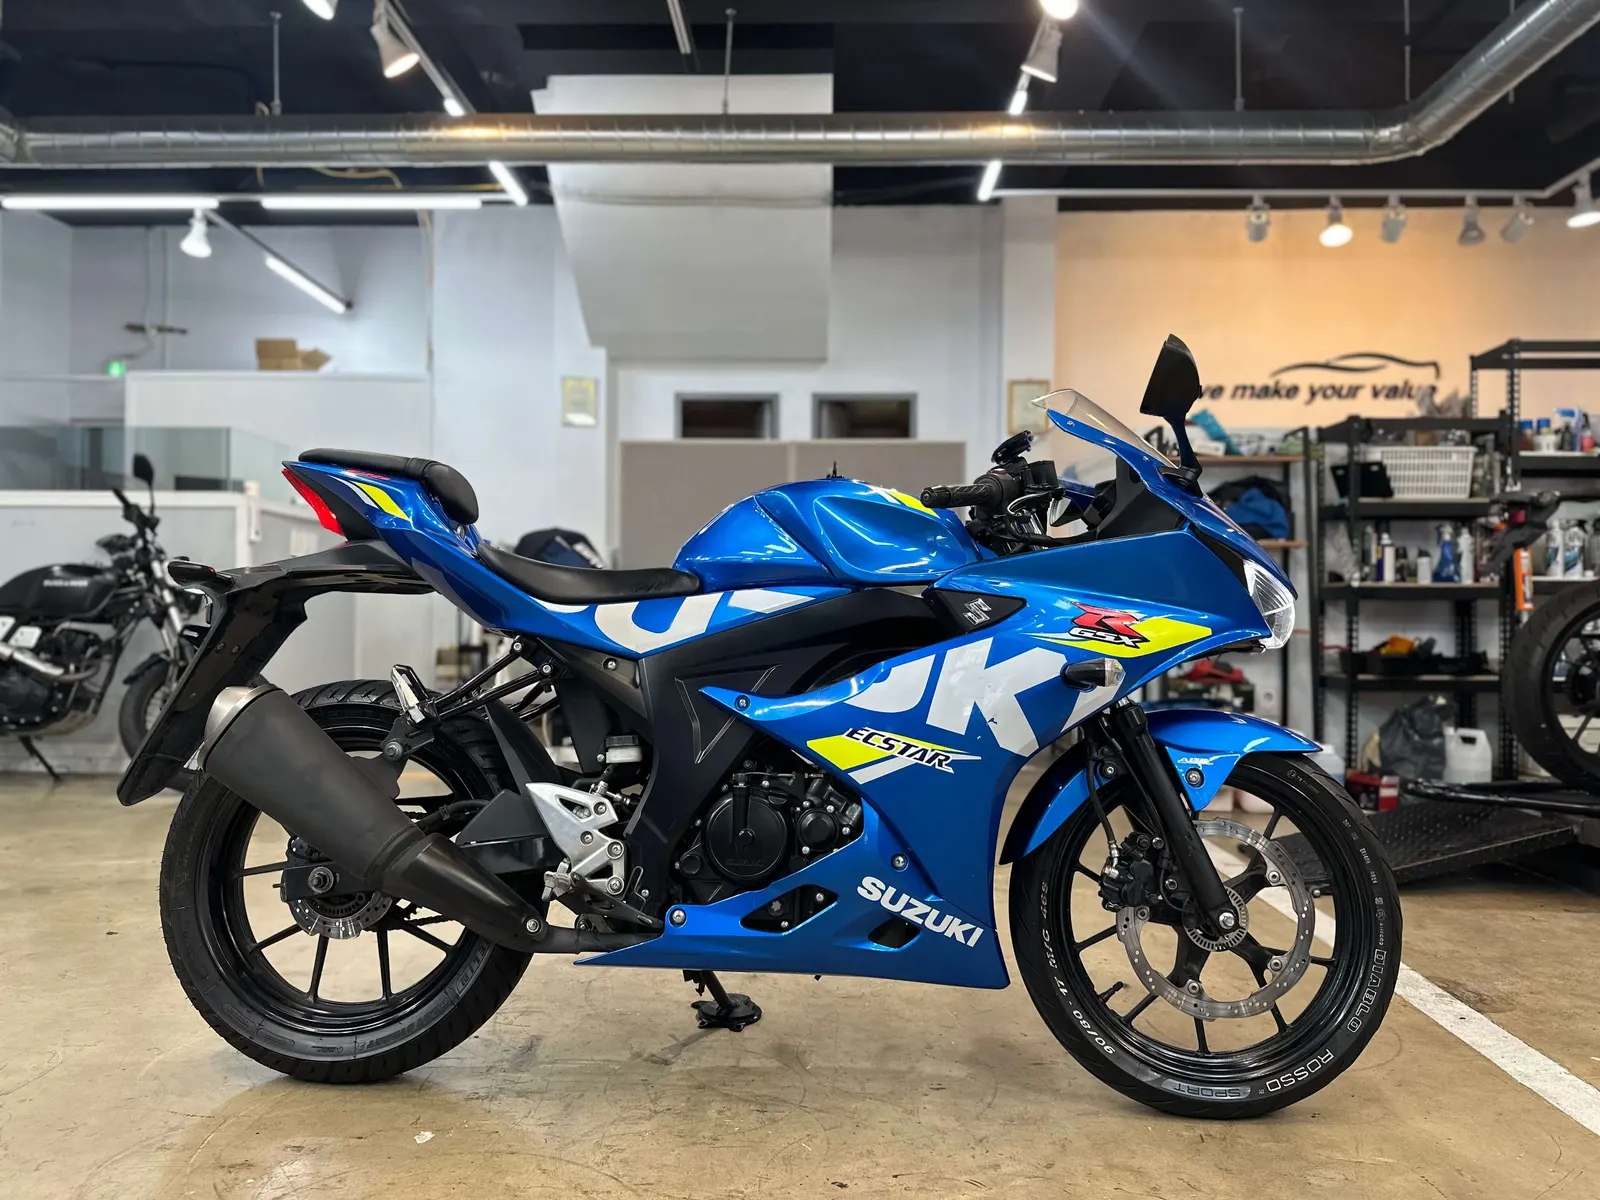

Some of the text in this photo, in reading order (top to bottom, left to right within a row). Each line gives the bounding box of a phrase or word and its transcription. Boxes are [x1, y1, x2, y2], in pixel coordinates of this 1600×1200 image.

[1230, 379, 1299, 400] make
[1304, 384, 1365, 406] your
[845, 727, 955, 773] ECSTAR
[857, 876, 984, 947] SUZUKI
[1054, 976, 1068, 996] 17
[1346, 948, 1387, 1034] DIABLO
[1073, 1009, 1115, 1055] 90/80
[1174, 1083, 1242, 1098] SPORT
[1265, 1048, 1335, 1092] ROSSO
